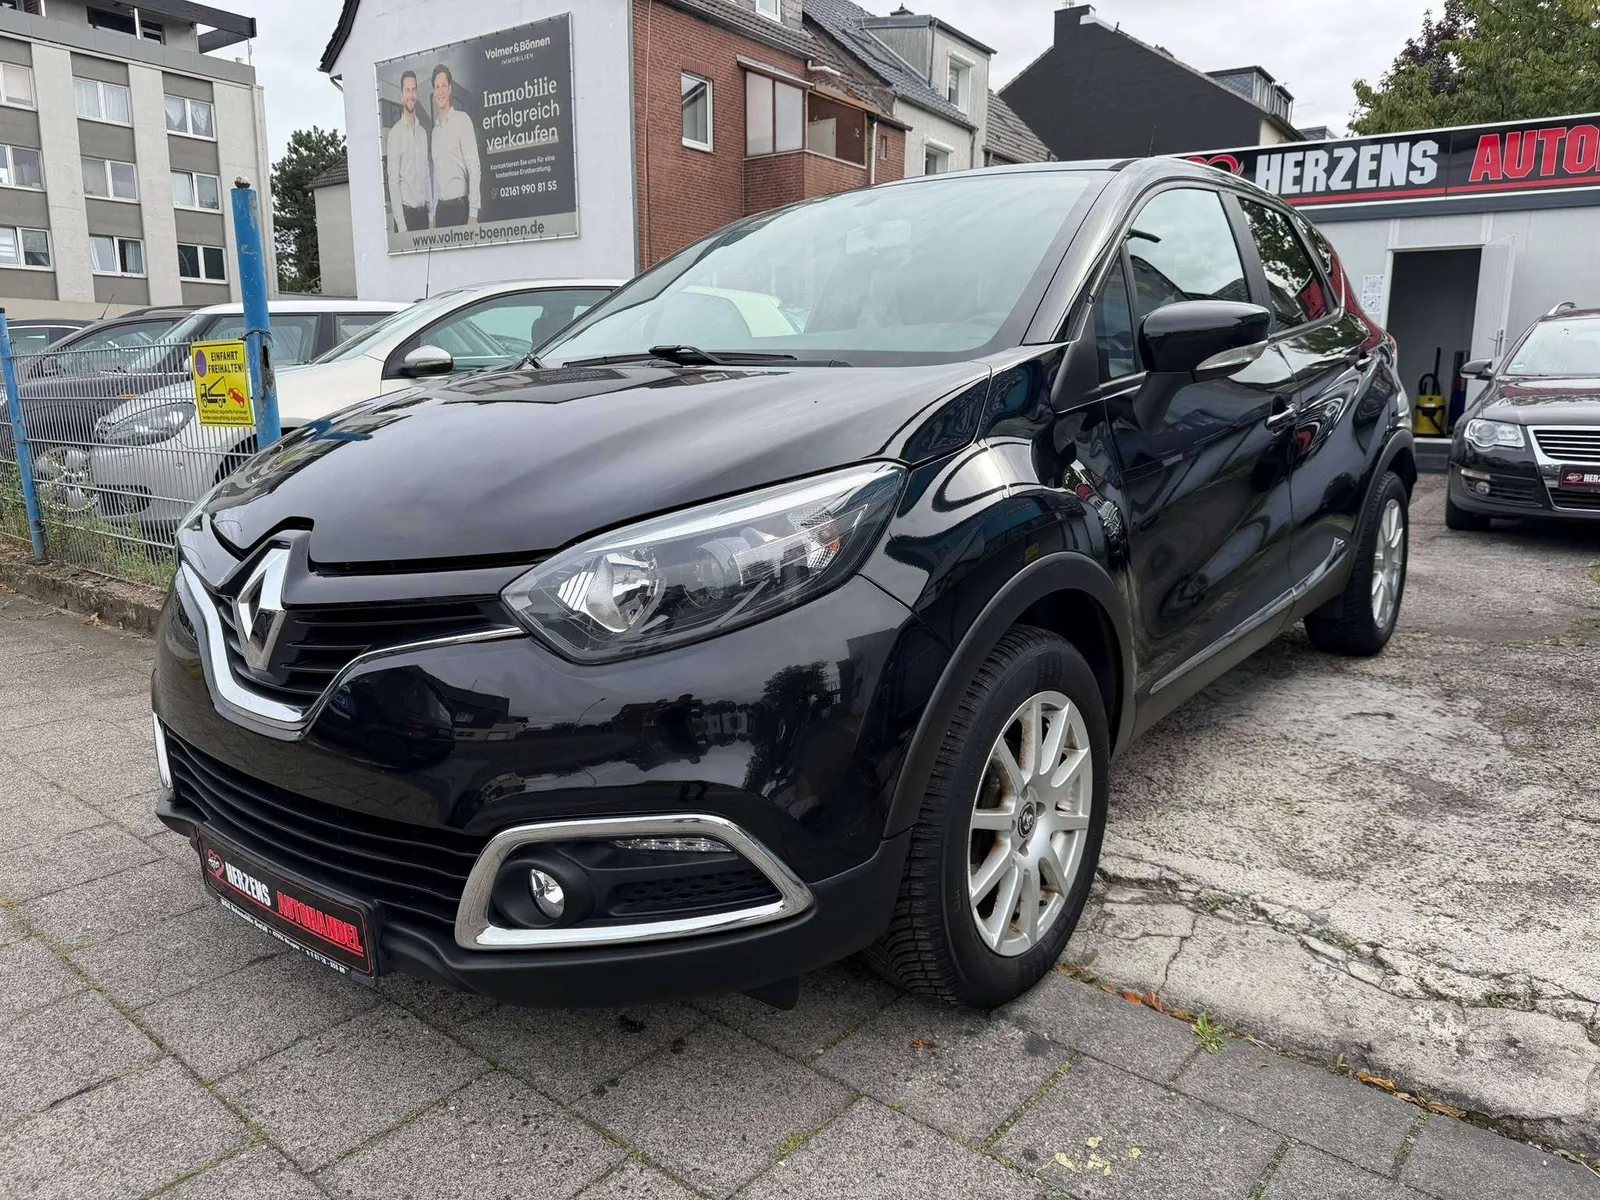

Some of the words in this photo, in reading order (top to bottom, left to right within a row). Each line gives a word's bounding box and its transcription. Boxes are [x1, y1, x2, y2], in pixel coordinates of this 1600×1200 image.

[500, 53, 534, 65] IMMOBILIEN
[483, 76, 557, 108] Immobilie
[482, 98, 560, 130] erfolgreich
[486, 124, 558, 151] verkaufen
[490, 161, 519, 170] Kontaktieren
[545, 154, 555, 162] eine
[1255, 140, 1439, 195] HERZENS
[1468, 124, 1600, 182] AUTO
[495, 170, 520, 179] kostenlose
[500, 185, 520, 197] 02161
[521, 183, 536, 195] 990
[537, 181, 546, 193] 81
[547, 180, 558, 191] 55
[412, 219, 545, 247] www.volmer-boennen.de
[210, 350, 238, 361] EINFAHRT
[207, 363, 244, 374] FREIHALTEN!
[1583, 473, 1600, 483] HER
[225, 861, 271, 907] HERZENS
[276, 890, 364, 953] AUTOHANDEL
